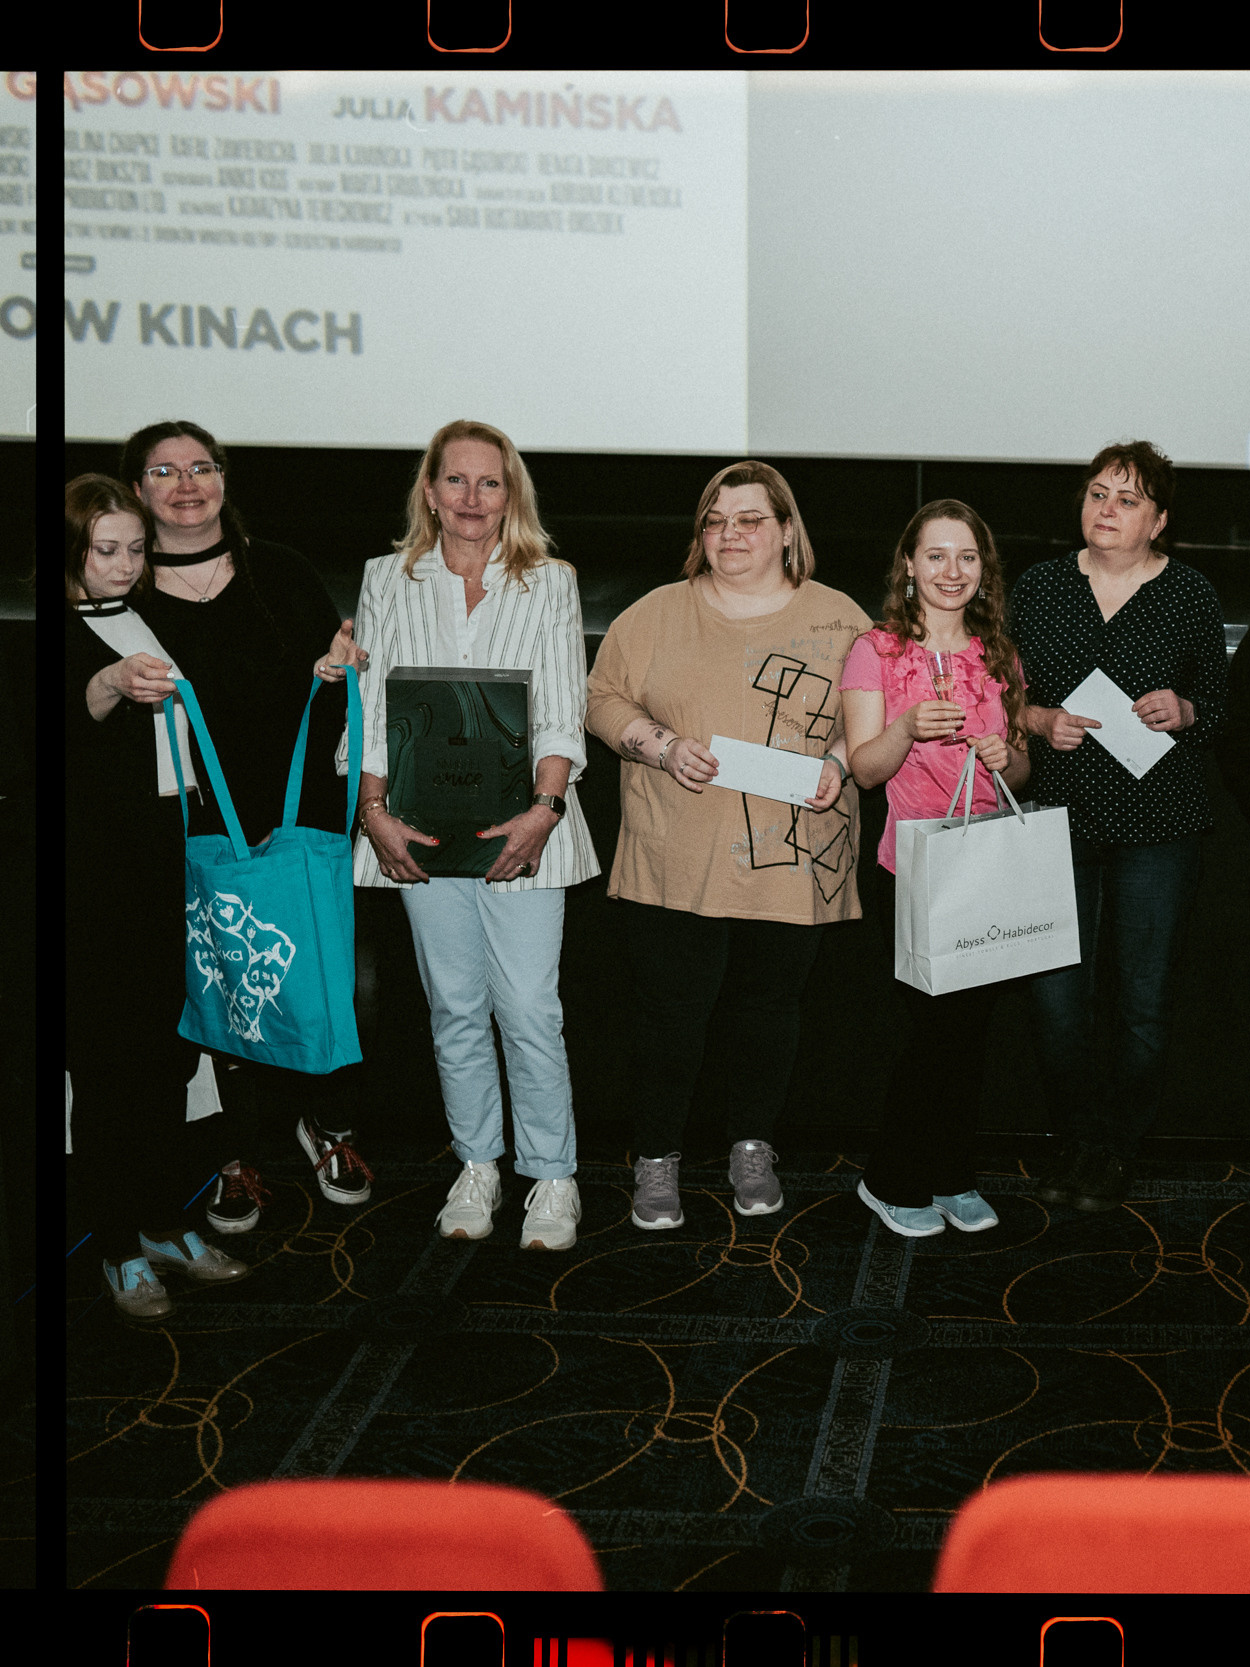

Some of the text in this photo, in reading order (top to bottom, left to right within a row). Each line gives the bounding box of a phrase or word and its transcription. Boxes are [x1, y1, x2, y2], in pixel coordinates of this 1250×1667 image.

[333, 82, 683, 133] JULIA KAMIŃSKA
[138, 302, 364, 356] KINACH
[955, 922, 1054, 950] Abyss Habidecor
